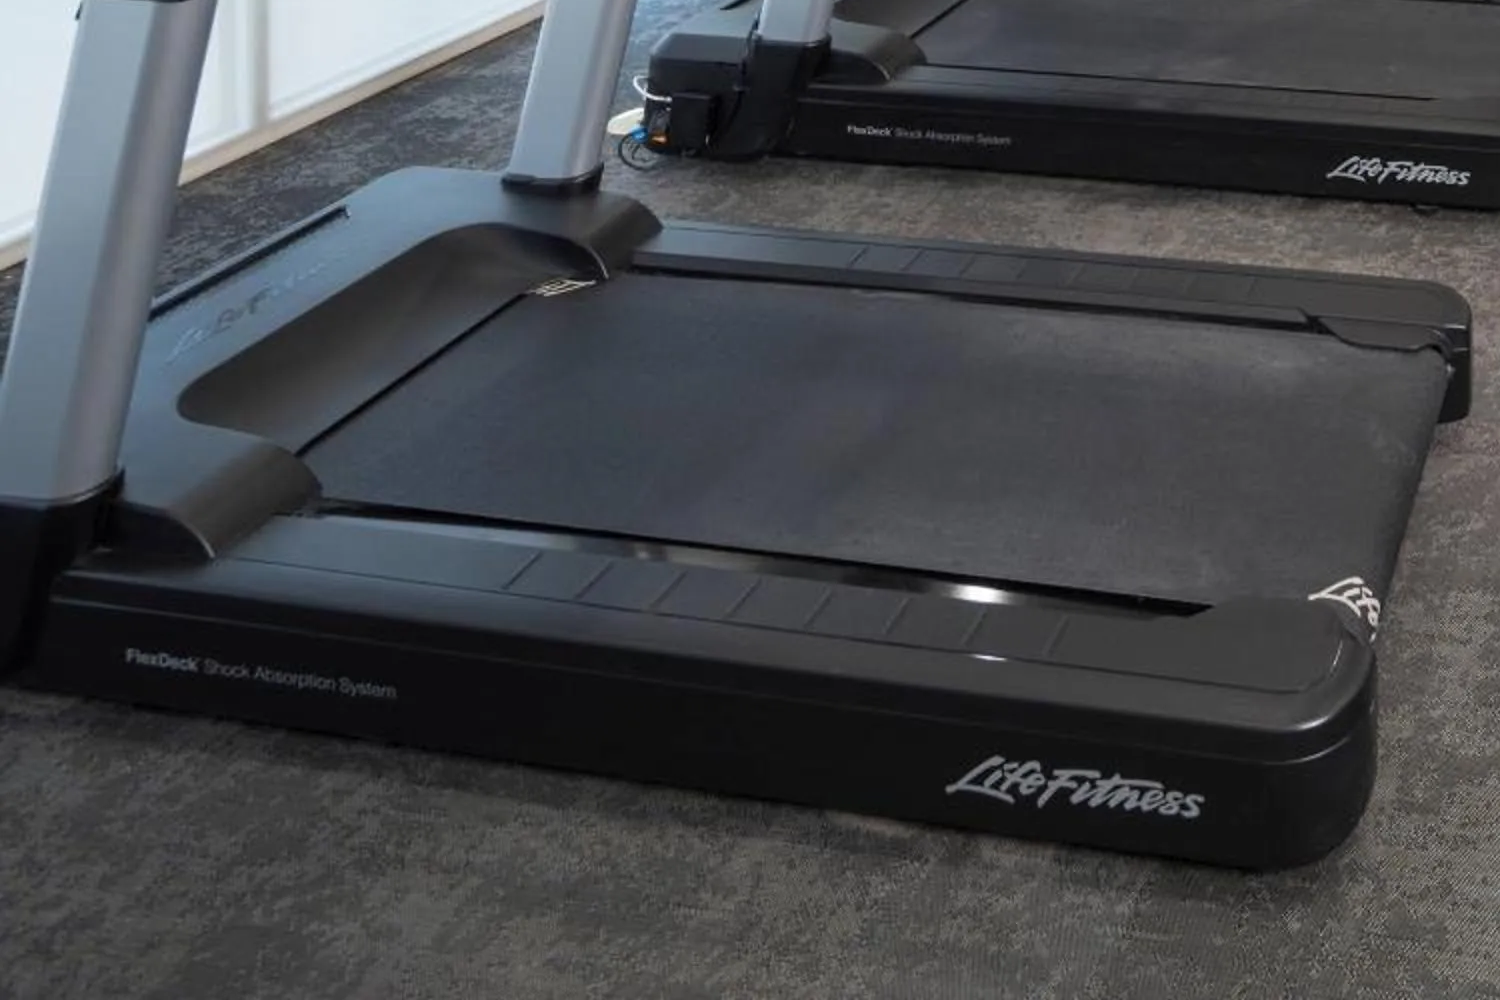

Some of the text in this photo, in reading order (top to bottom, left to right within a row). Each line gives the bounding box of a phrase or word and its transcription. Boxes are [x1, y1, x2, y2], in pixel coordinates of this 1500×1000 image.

[125, 648, 397, 699] FlexDeck Shock Absorption System
